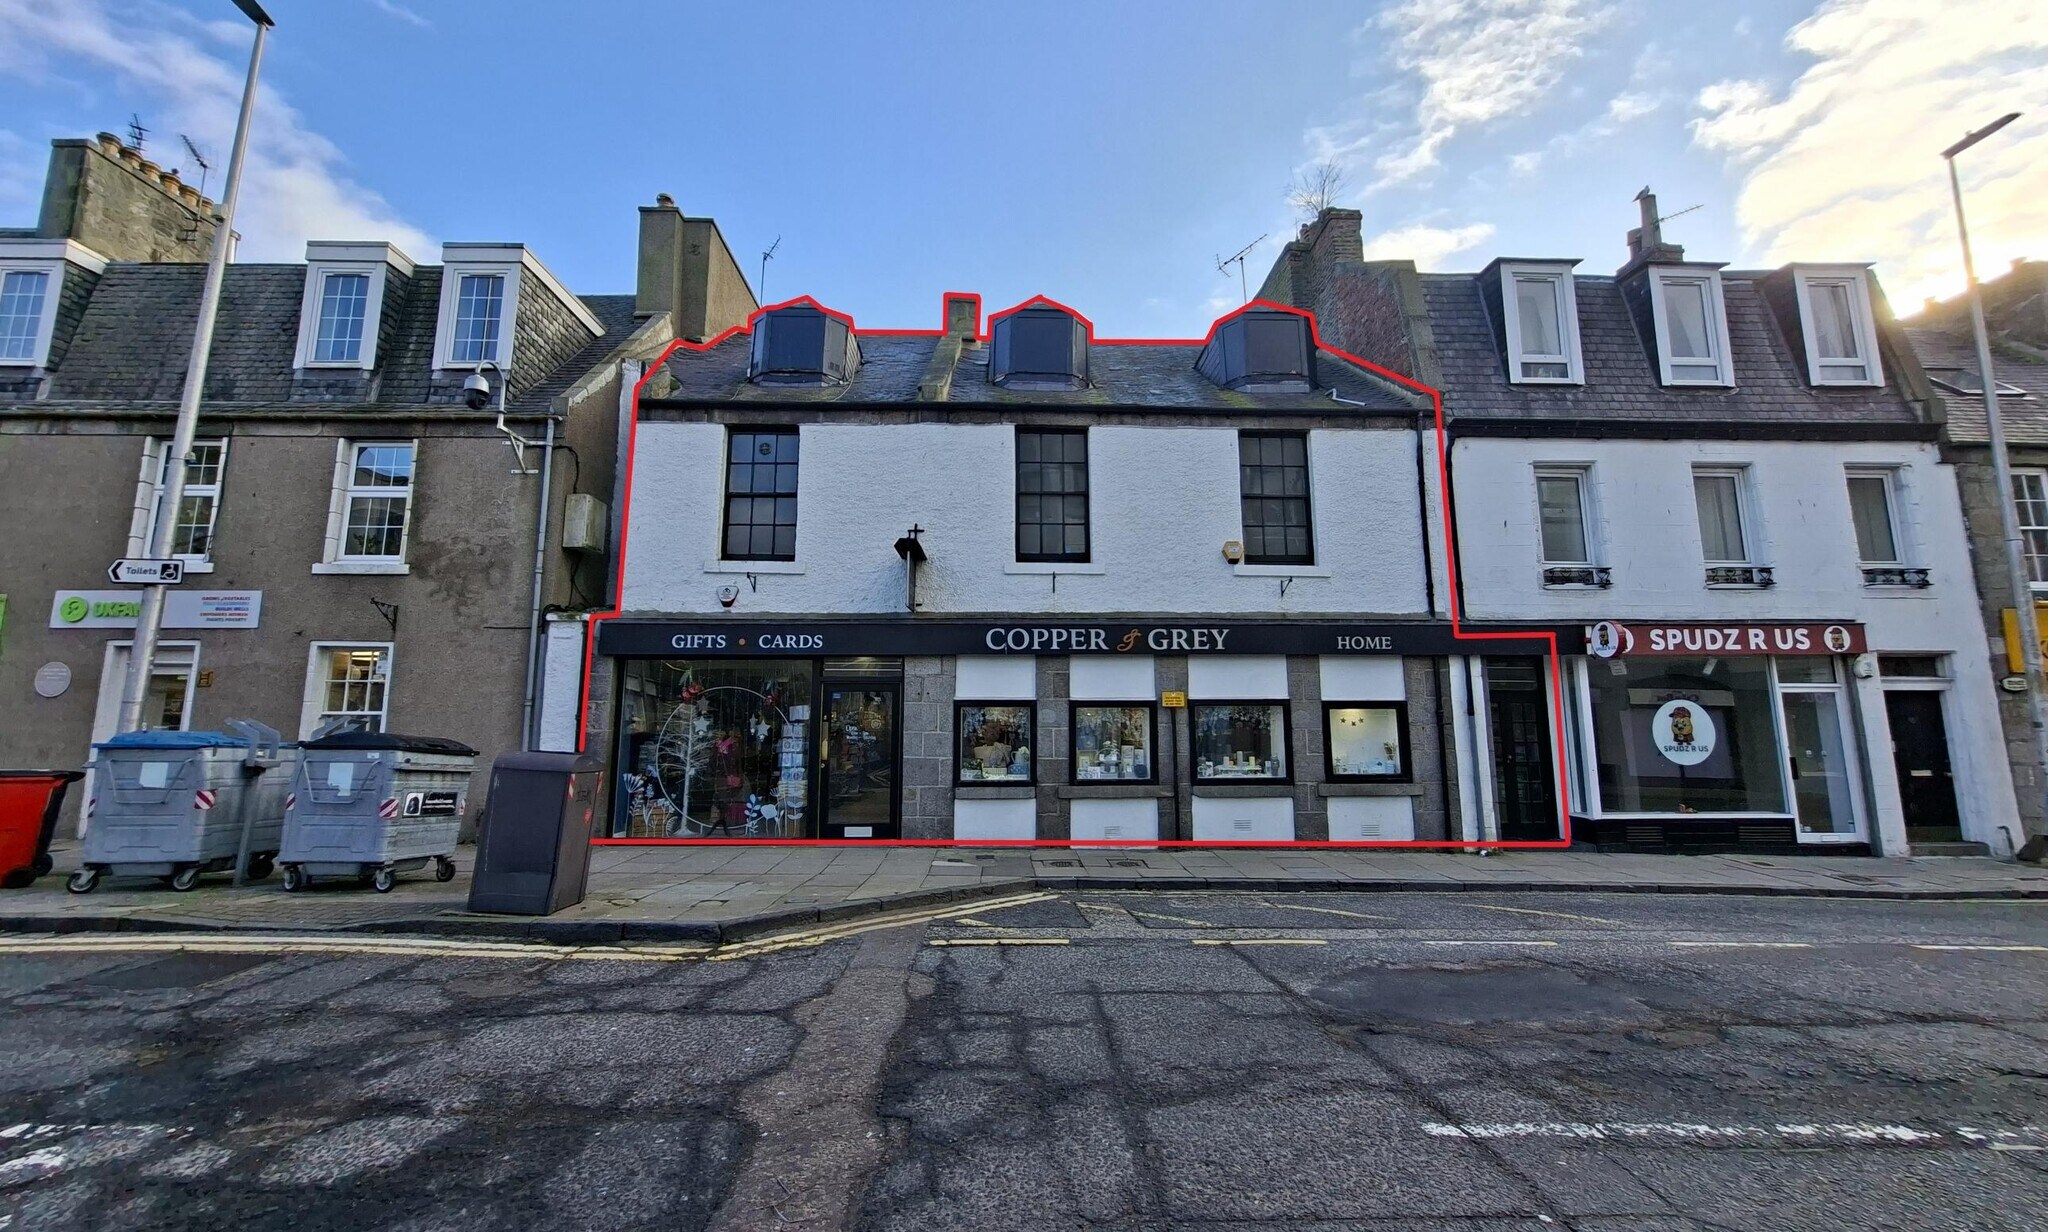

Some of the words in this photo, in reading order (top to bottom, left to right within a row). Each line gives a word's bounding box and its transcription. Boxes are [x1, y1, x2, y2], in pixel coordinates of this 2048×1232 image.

[126, 566, 158, 575] Toilets
[671, 634, 727, 649] GIFTS
[758, 634, 824, 649] CARDS
[985, 628, 1110, 651] COPPER
[1147, 628, 1230, 651] GREY
[1336, 636, 1393, 650] HOME
[1650, 628, 1741, 651] SPUDZ
[1748, 628, 1768, 650] R
[1774, 628, 1811, 650] US
